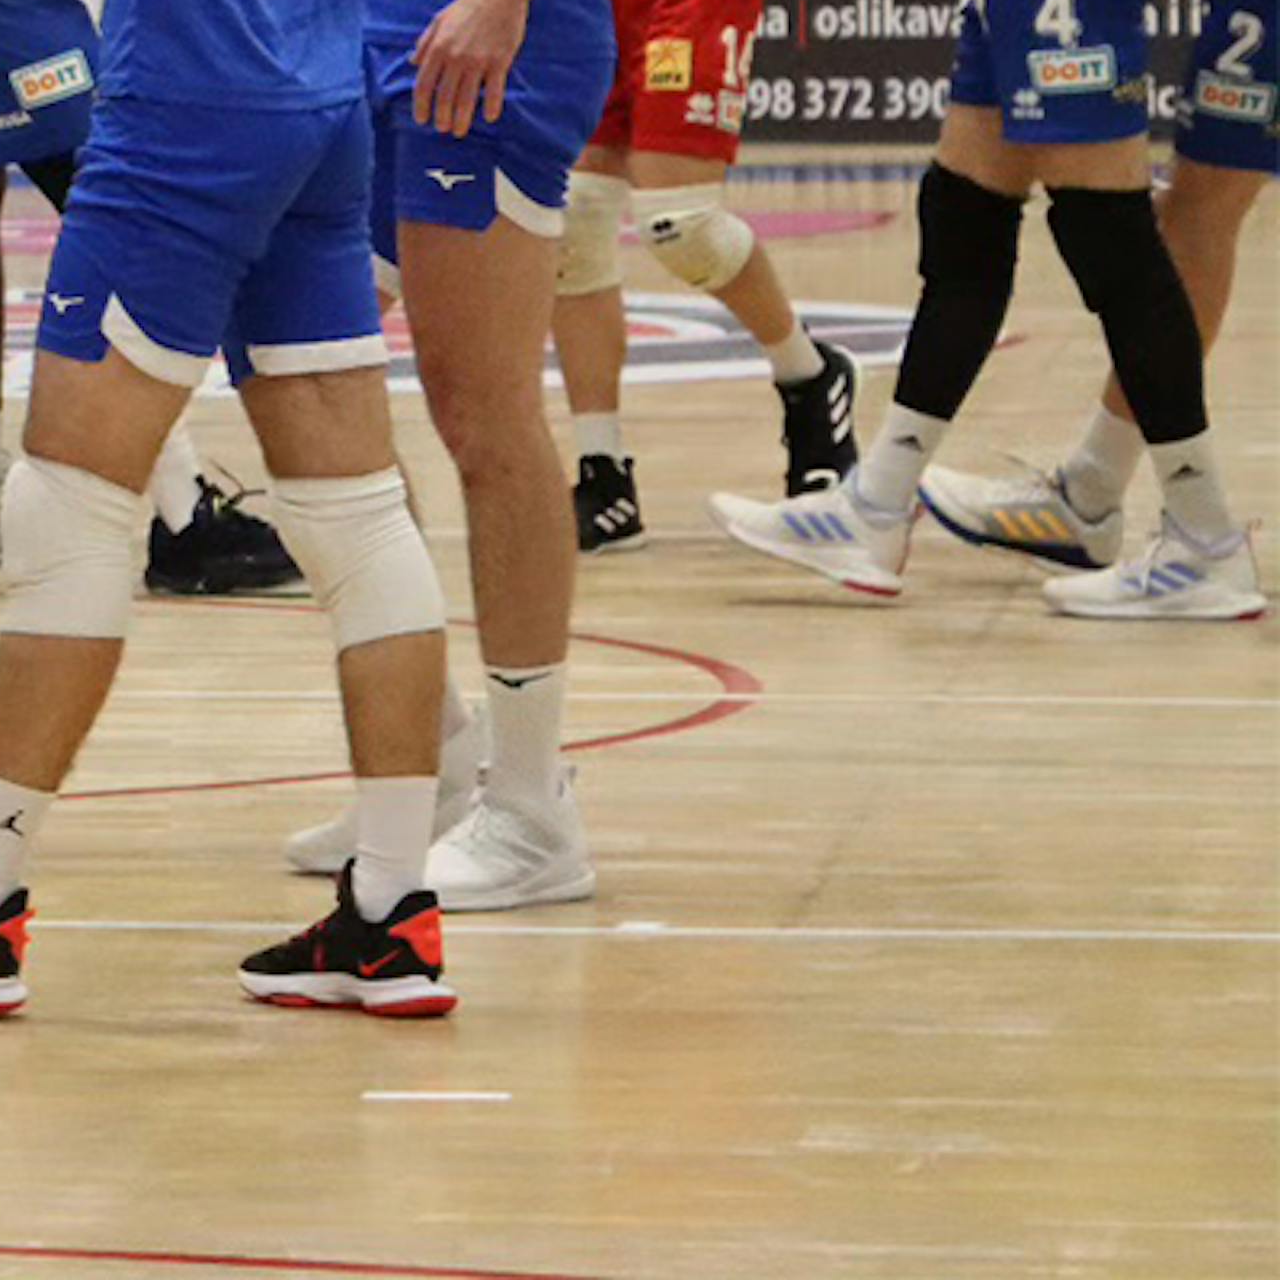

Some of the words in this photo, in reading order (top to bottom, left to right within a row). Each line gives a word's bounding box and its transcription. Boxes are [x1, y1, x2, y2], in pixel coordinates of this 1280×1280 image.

[1216, 10, 1267, 76] 2
[23, 63, 80, 98] DOIT
[1042, 60, 1105, 83] DOIT
[802, 77, 874, 120] 372
[1202, 84, 1266, 111] DOIT
